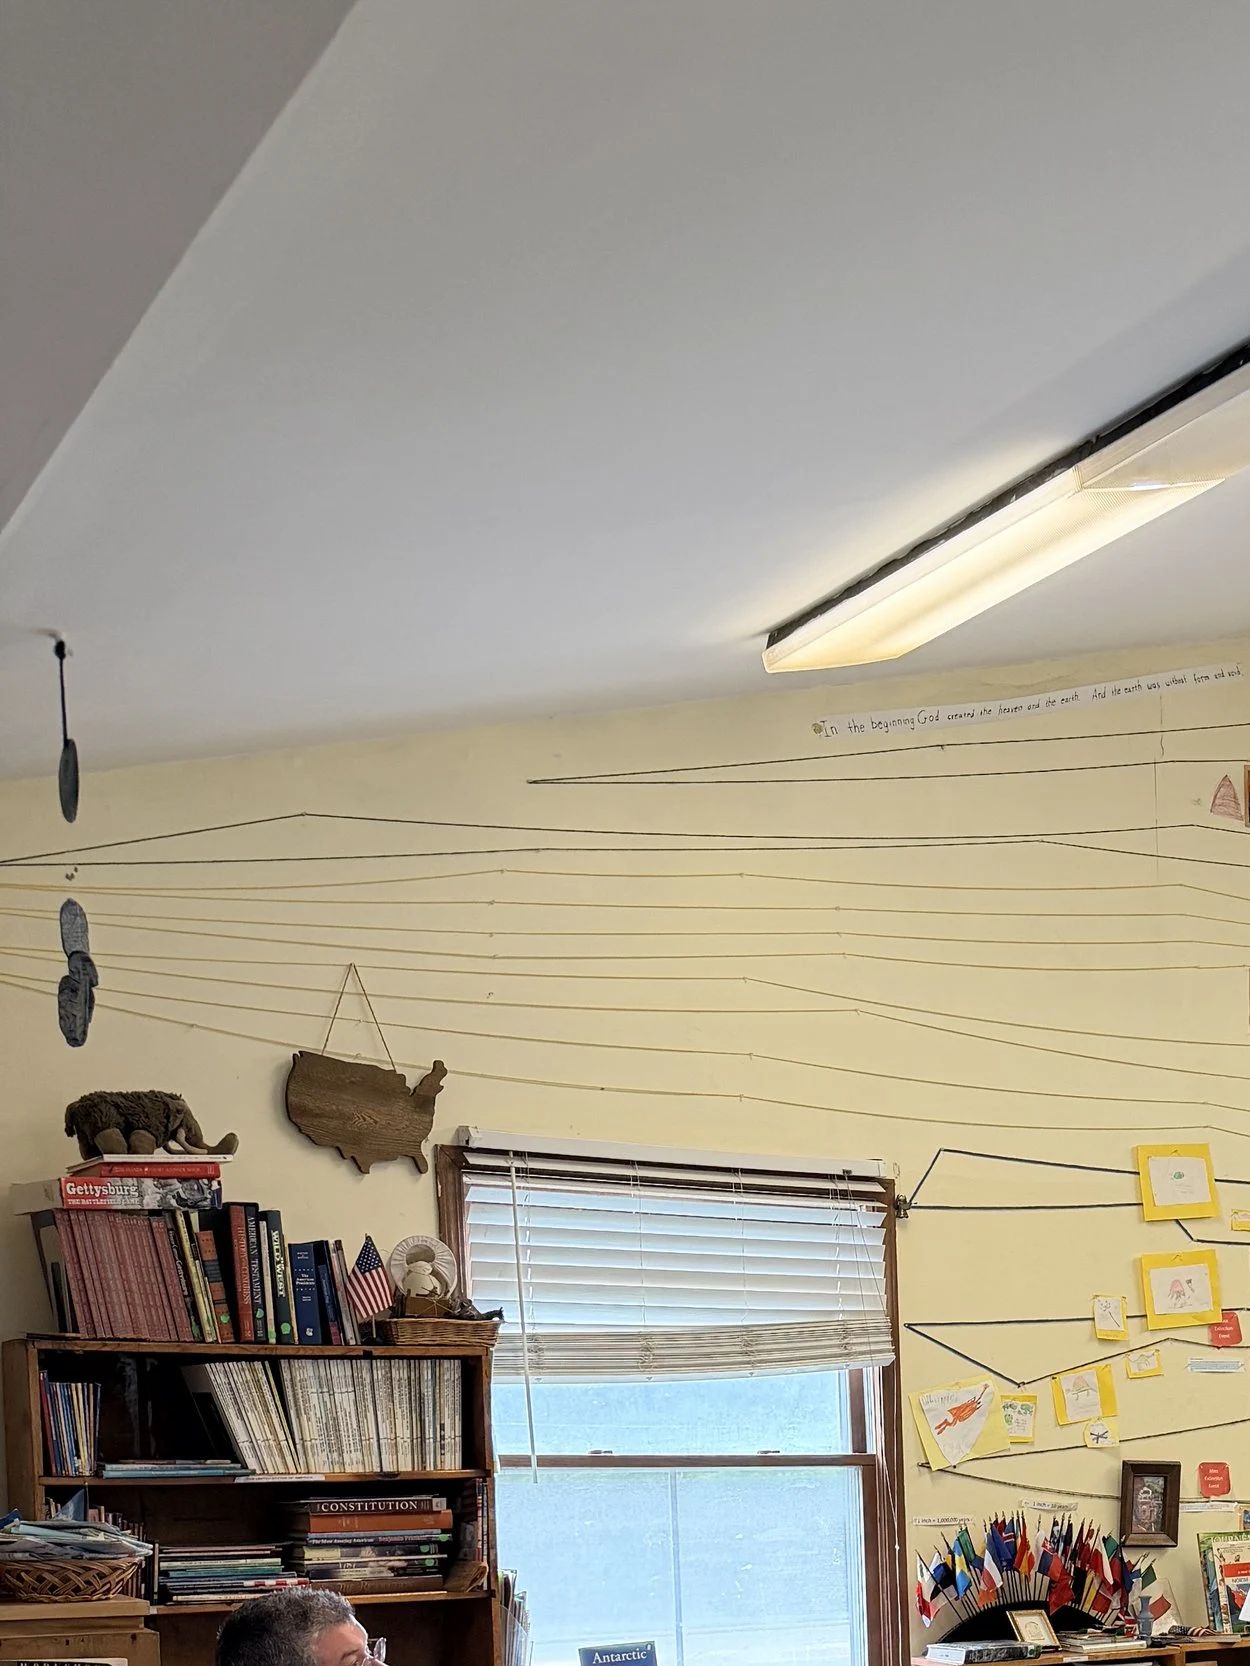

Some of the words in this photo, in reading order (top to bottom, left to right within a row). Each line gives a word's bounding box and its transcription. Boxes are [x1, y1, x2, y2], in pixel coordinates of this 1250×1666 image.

[820, 720, 838, 738] In
[848, 717, 865, 734] the
[870, 715, 915, 734] beginning
[917, 709, 940, 725] God
[947, 708, 975, 721] created
[980, 706, 992, 717] the
[998, 704, 1023, 714] heaven
[1027, 698, 1040, 711] and
[1045, 696, 1056, 708] the
[1091, 686, 1107, 700] And
[1111, 684, 1121, 695] the
[1124, 679, 1143, 694] earth
[1147, 681, 1161, 691] was
[1165, 674, 1187, 687] without
[1193, 673, 1210, 684] form
[1214, 668, 1226, 680] and
[65, 1183, 139, 1198] Gettysburg
[247, 1216, 258, 1255] AMERICAN
[271, 1230, 281, 1259] WILD
[276, 1259, 286, 1297] WEST
[250, 1259, 262, 1304] TESTAMENT
[321, 1500, 418, 1512] CONSTITUTION
[378, 1535, 404, 1543] Benjamin
[592, 1647, 648, 1664] Antarctic
